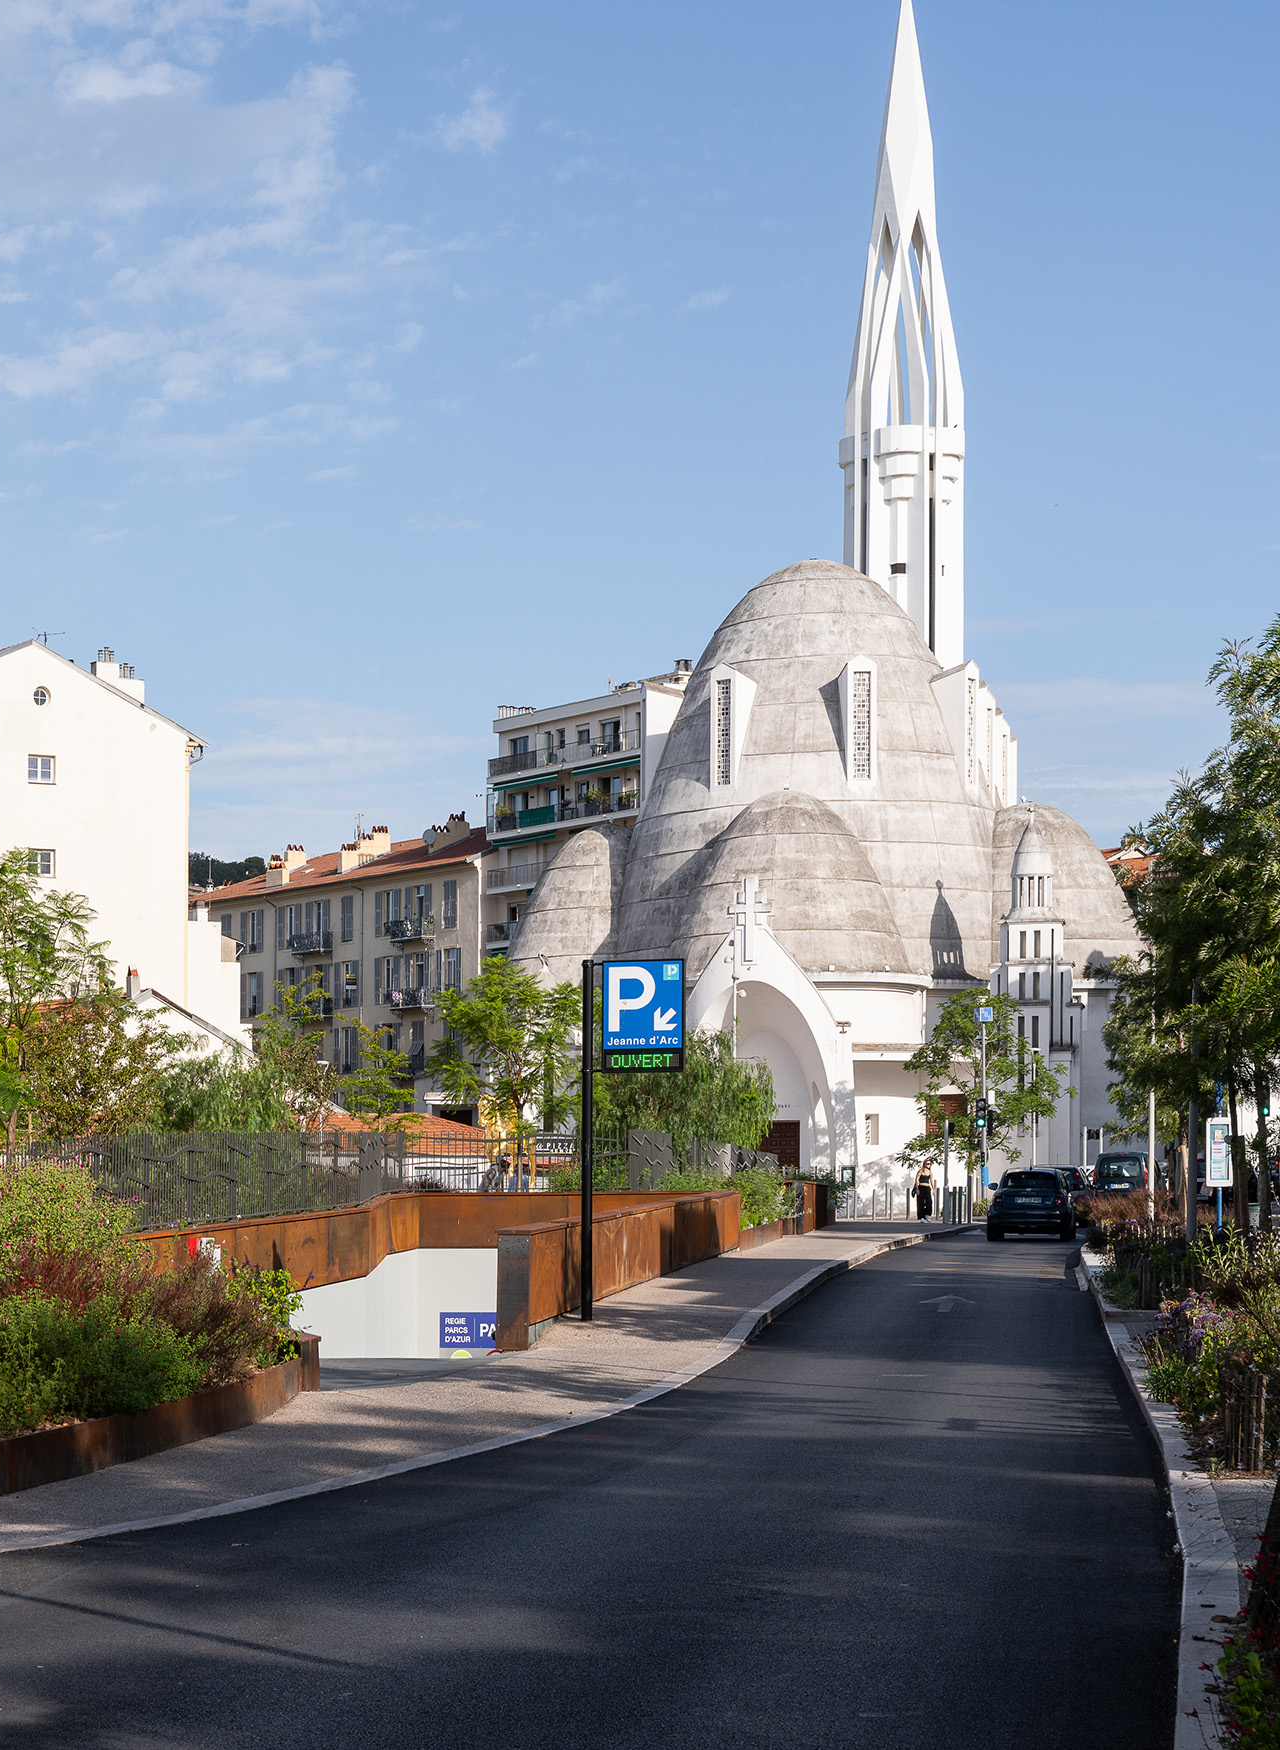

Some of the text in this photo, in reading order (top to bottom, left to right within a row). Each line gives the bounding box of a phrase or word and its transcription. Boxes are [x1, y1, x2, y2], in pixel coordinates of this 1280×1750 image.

[608, 966, 656, 1032] P
[607, 1036, 679, 1046] Jeanne d'Arc
[611, 1054, 673, 1068] OUVERT
[444, 1317, 466, 1325] REGIE
[444, 1326, 468, 1334] PARCS
